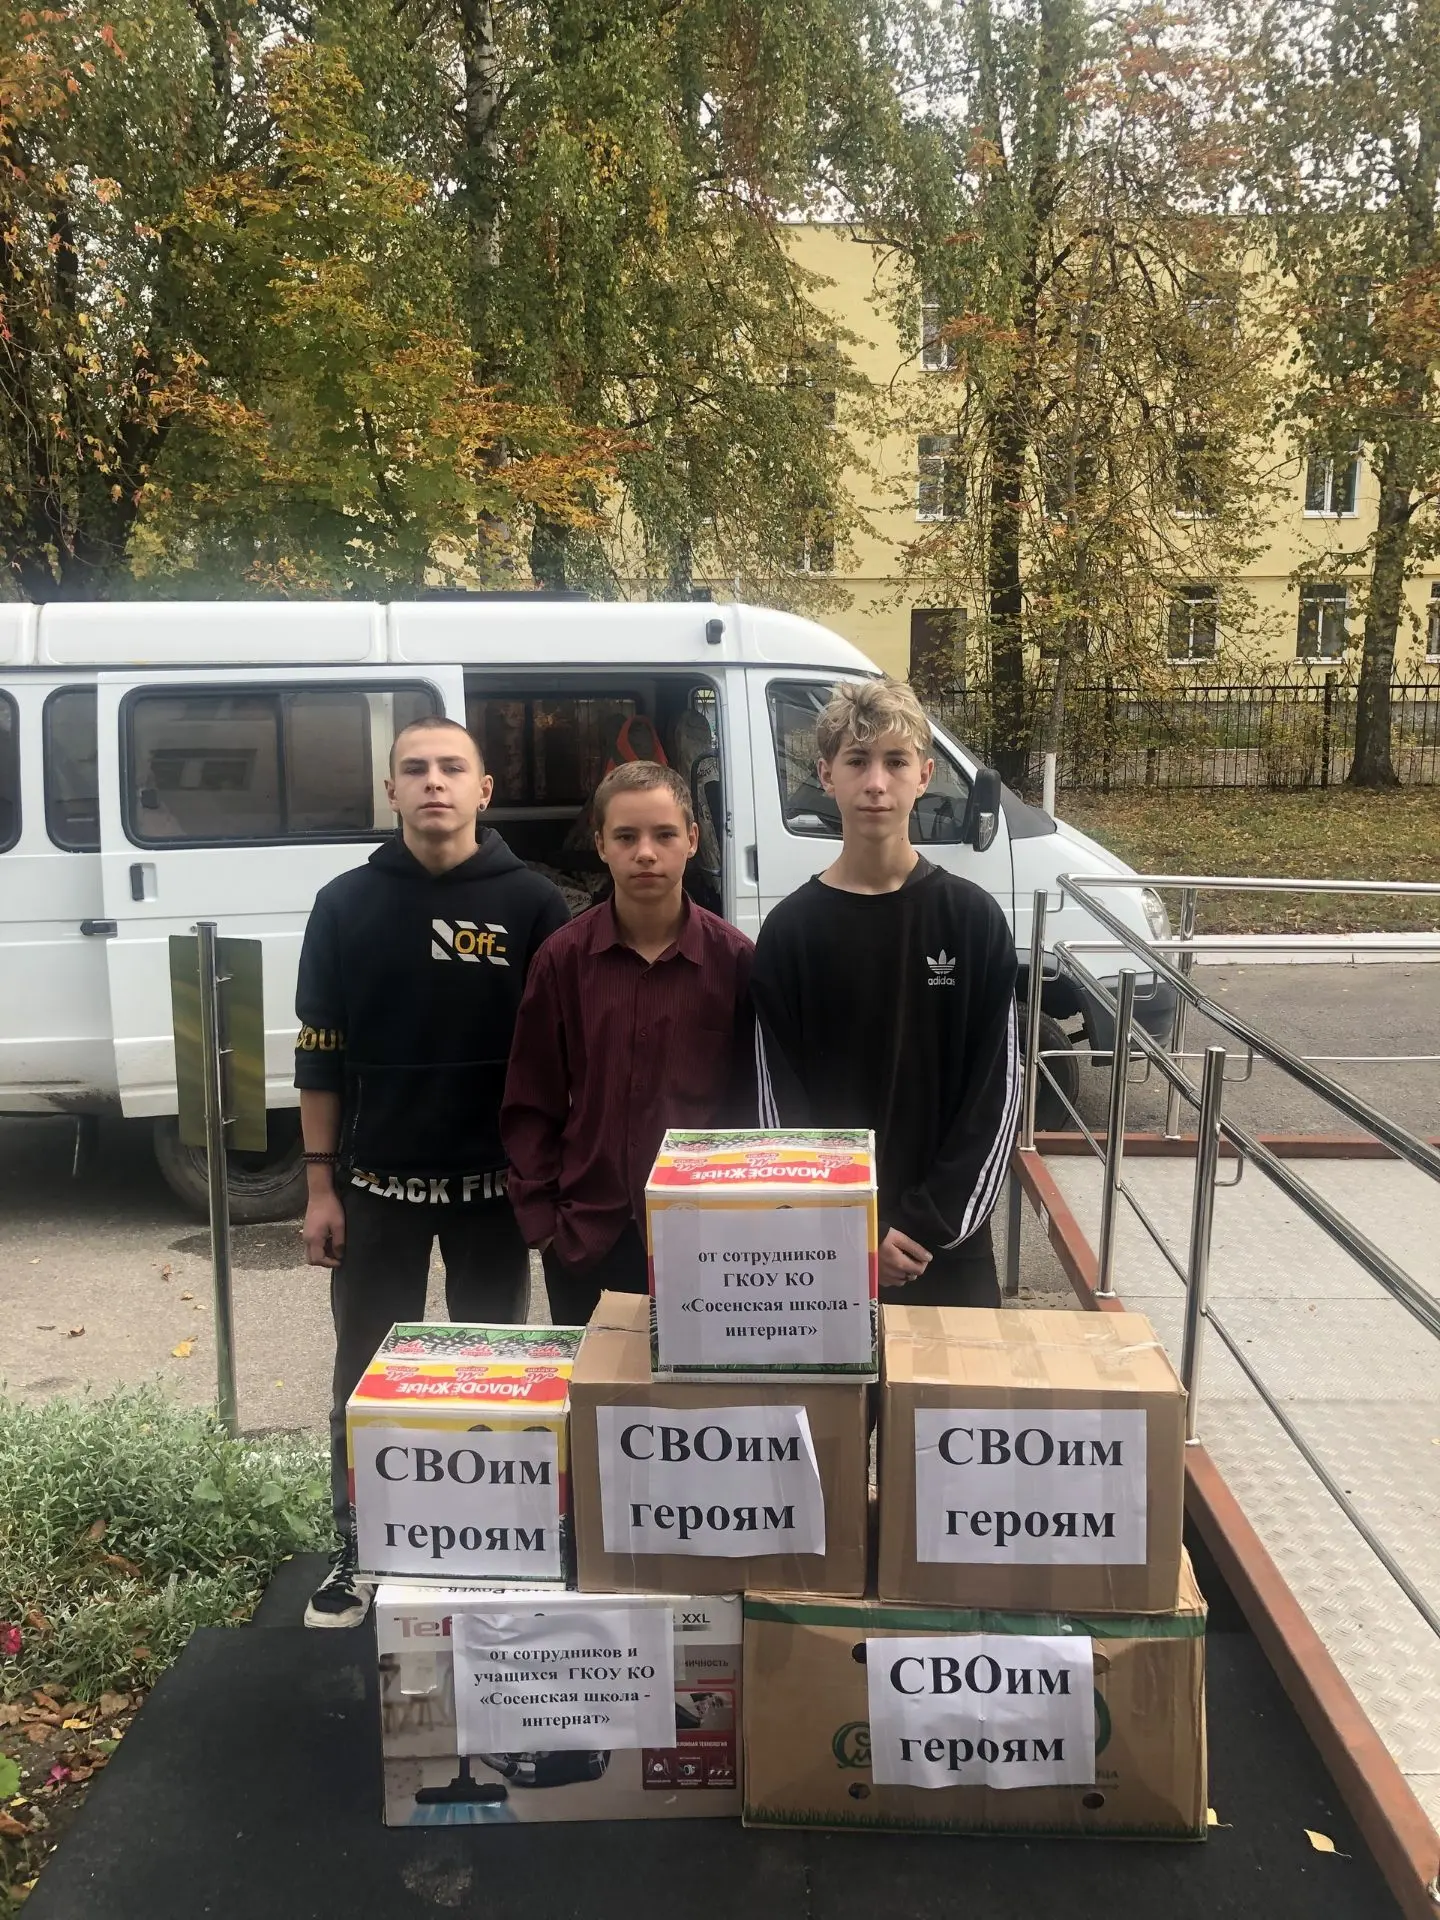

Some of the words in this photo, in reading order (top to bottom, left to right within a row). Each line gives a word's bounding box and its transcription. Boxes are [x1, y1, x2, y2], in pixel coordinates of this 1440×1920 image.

[455, 930, 507, 956] Off-
[927, 975, 956, 986] adidas
[698, 1252, 717, 1263] от
[722, 1249, 837, 1266] сотрудников
[723, 1272, 779, 1288] ГКОУ
[785, 1271, 815, 1287] КО
[681, 1298, 783, 1313] «Сосенская
[789, 1299, 848, 1312] школа
[725, 1325, 818, 1341] интернат»
[620, 1423, 801, 1463] СВОим
[937, 1427, 1124, 1466] СВОим
[375, 1445, 552, 1486] СВОим
[629, 1503, 796, 1540] героям
[945, 1510, 1116, 1548] героям
[383, 1522, 547, 1559] героям
[682, 1612, 711, 1625] XXL
[488, 1651, 509, 1662] от
[513, 1648, 623, 1664] сотрудников
[627, 1647, 638, 1658] и
[474, 1671, 558, 1687] учащихся
[568, 1667, 622, 1681] ГКОУ
[627, 1665, 655, 1680] КО
[889, 1654, 1073, 1696] СВОим
[479, 1691, 579, 1706] «Сосенская
[584, 1691, 640, 1703] школа
[522, 1714, 611, 1730] интернат»
[899, 1737, 1065, 1772] героям
